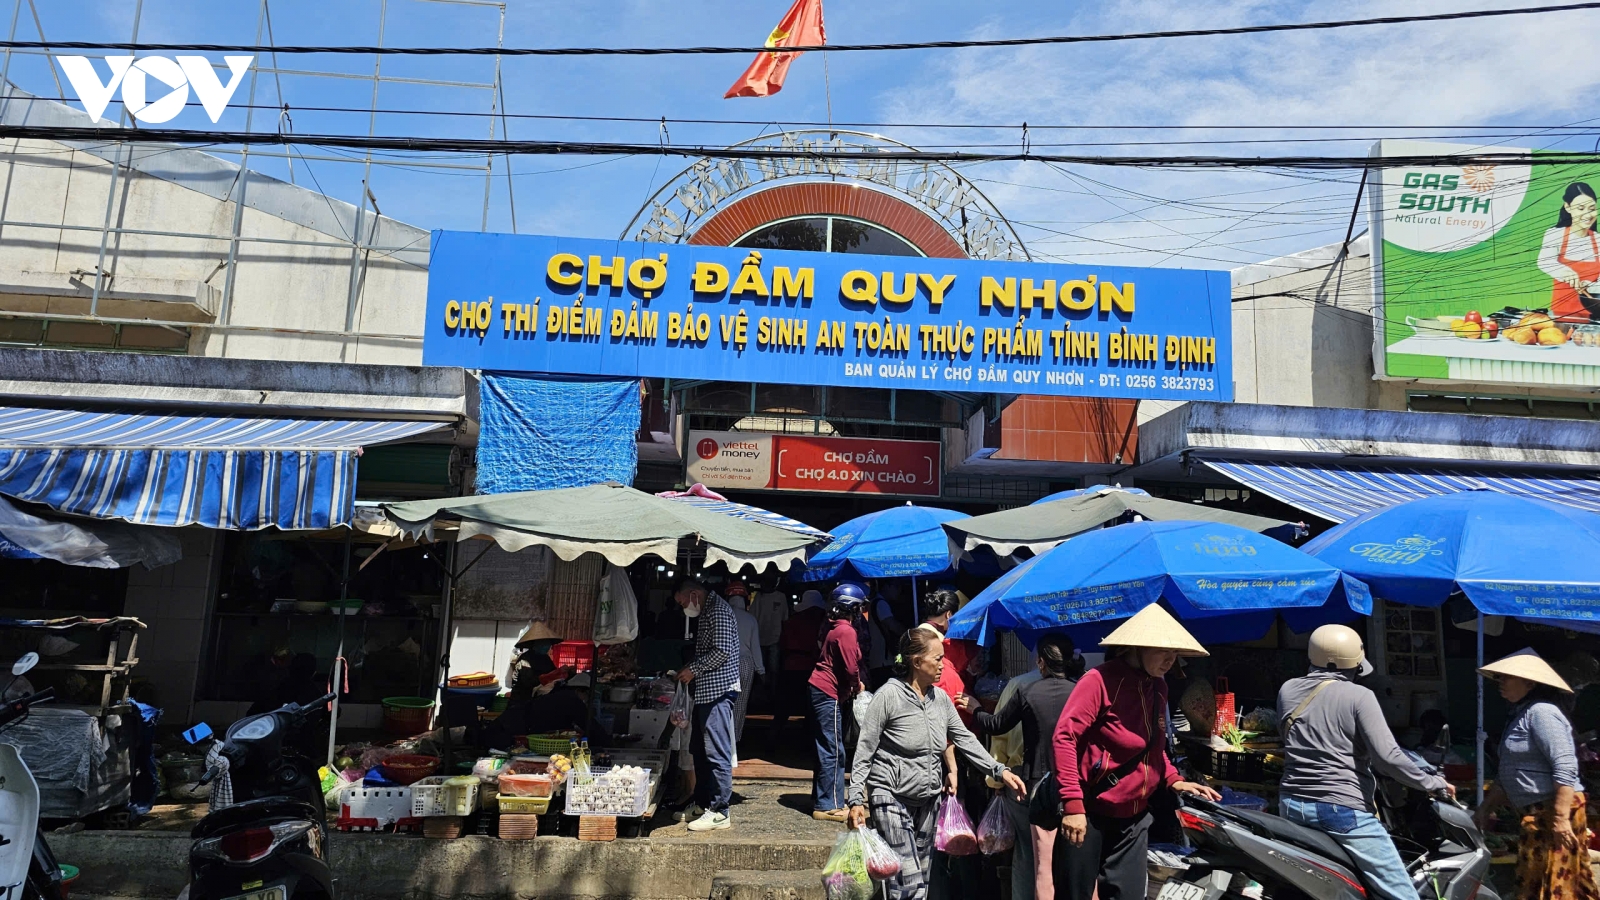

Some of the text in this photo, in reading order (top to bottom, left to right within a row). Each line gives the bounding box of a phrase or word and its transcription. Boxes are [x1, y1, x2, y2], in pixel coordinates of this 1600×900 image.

[1403, 172, 1460, 191] GAS
[1398, 193, 1491, 215] SOUTH
[1395, 213, 1487, 229] Natural Energy
[547, 251, 1135, 313] CHỢ ĐẦM QUY NHƠN
[445, 293, 1216, 371] CHỢ THÍ ĐIỂM ĐẢM BẢO VỆ SINH AN TOÀN THỰC PHẨM TỈNH BÌNH ĐỊNH
[845, 363, 872, 376] BAN
[878, 360, 916, 379] QUẢN
[921, 360, 938, 378] LÝ
[944, 365, 973, 383] CHỢ
[978, 363, 1007, 382] ĐẦM
[1012, 370, 1040, 385] QUY
[1046, 369, 1084, 386] NHƠN
[1098, 374, 1120, 387] ĐT:
[1125, 374, 1156, 389] 0256
[1161, 376, 1214, 391] 3823793
[722, 441, 759, 450] viettel
[721, 450, 760, 460] money
[824, 449, 889, 464] CHỢ ĐẦM
[795, 467, 917, 484] CHỢ 4.0 XIN CHÀO
